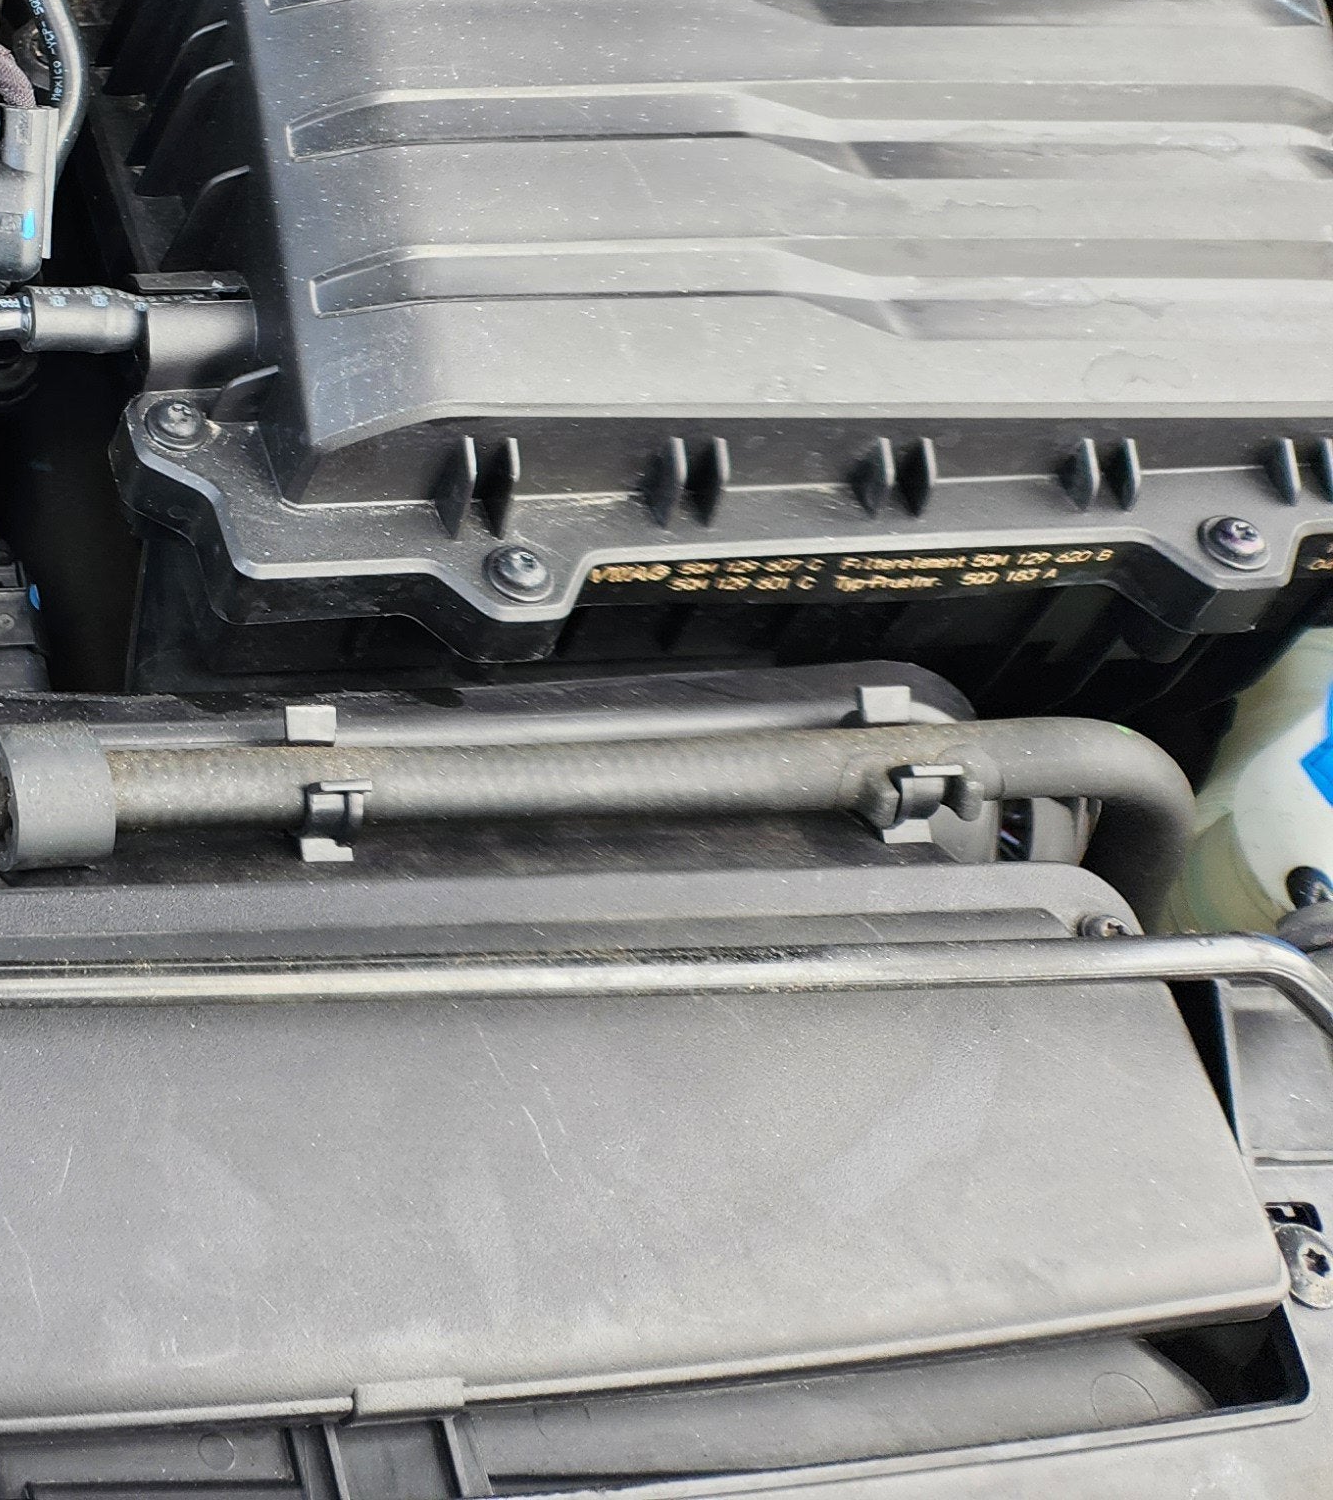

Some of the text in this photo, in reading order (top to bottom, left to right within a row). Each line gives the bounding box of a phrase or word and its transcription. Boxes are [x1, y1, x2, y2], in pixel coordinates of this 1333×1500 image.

[51, 60, 62, 102] Mexico
[840, 555, 968, 571] Filterelement
[1017, 551, 1053, 565] 129
[1055, 550, 1094, 564] 620
[714, 575, 752, 590] 129
[1042, 568, 1059, 580] A
